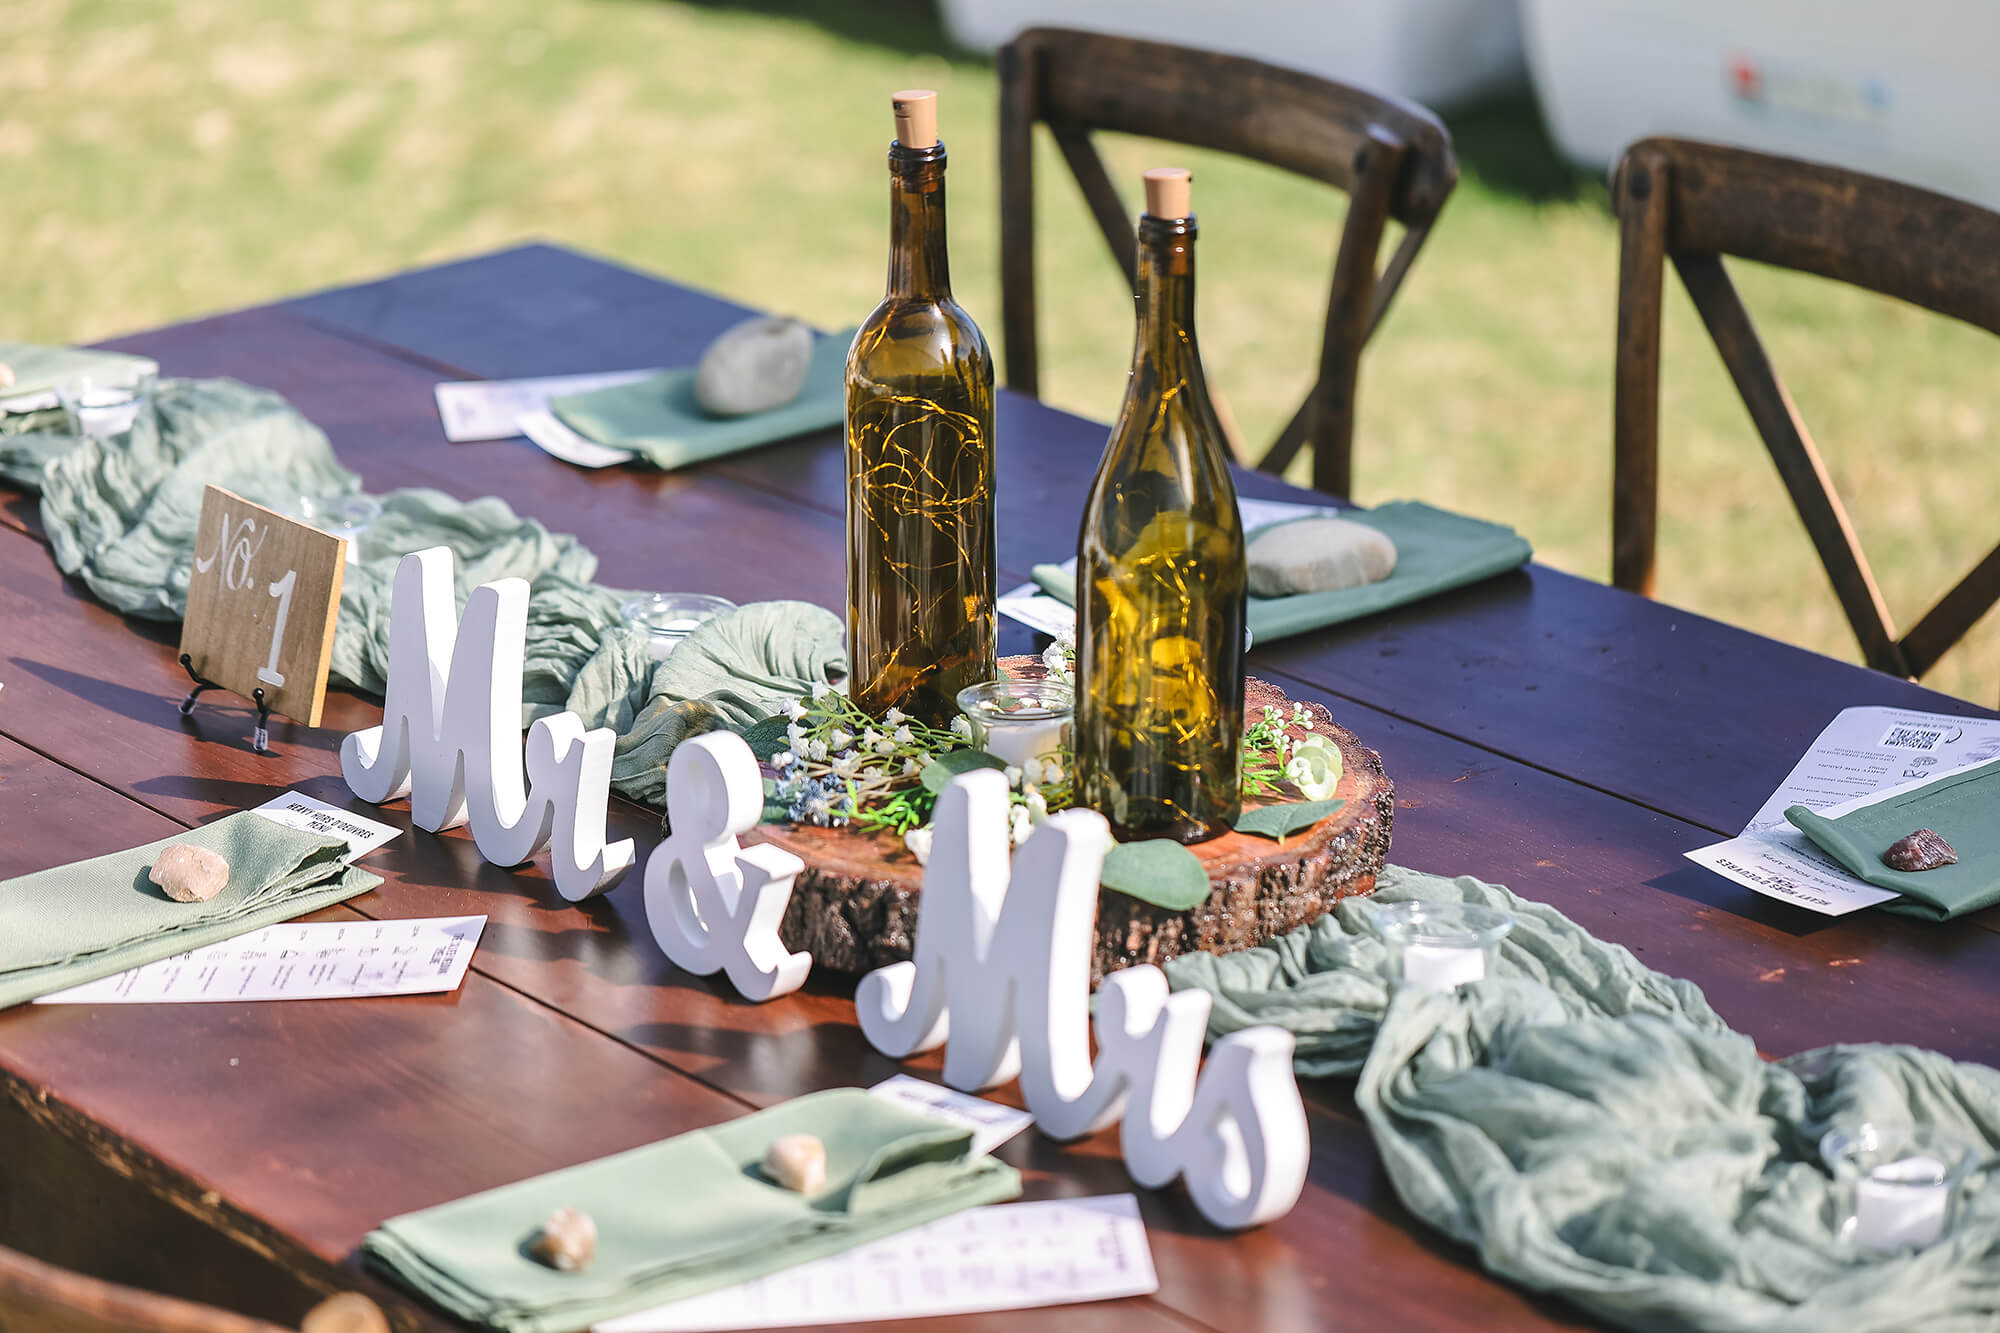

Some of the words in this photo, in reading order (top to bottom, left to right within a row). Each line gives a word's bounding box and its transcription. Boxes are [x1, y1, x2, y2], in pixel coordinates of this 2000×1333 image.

[256, 568, 297, 688] 1
[286, 802, 315, 816] HEAVY
[311, 812, 335, 824] HORS
[307, 821, 332, 833] MENU
[340, 545, 635, 902] Mr
[644, 730, 813, 1001] &
[855, 767, 1310, 1229] Mrs
